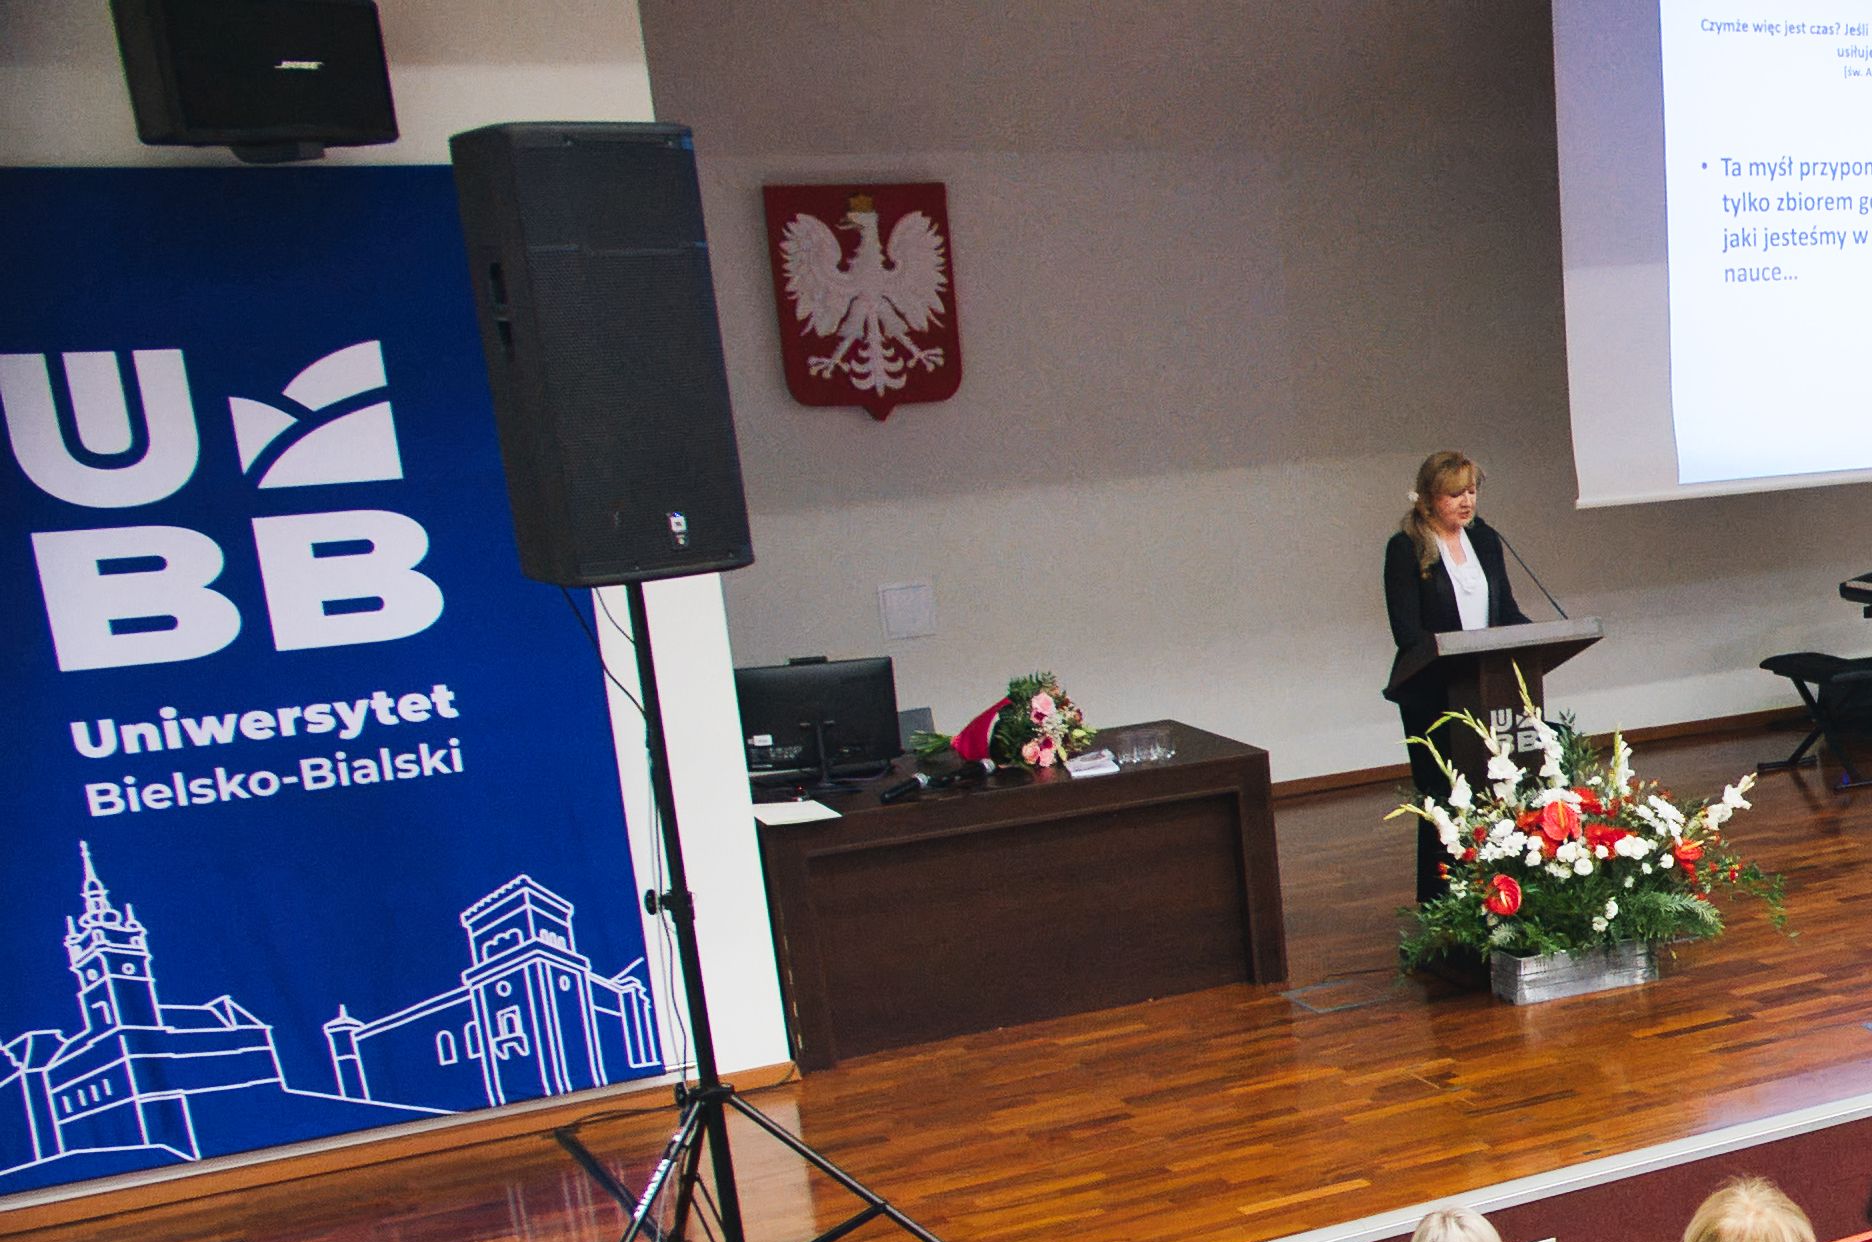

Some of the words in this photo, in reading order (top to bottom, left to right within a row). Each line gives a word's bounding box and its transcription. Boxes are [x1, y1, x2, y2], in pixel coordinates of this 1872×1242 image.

[1700, 18, 1749, 36] Czymże
[1752, 19, 1781, 37] więc
[1784, 20, 1806, 37] jest
[1809, 21, 1841, 36] czas?
[1844, 22, 1869, 37] Jeśli
[1720, 157, 1742, 177] Ta
[1722, 191, 1770, 218] tylko
[1776, 190, 1853, 212] zbiorem
[1722, 226, 1757, 254] jaki
[1763, 224, 1847, 251] jesteśmy
[1852, 229, 1869, 245] w
[69, 684, 460, 760] Uniwersytet
[84, 738, 465, 818] Bielsko-Bialski
